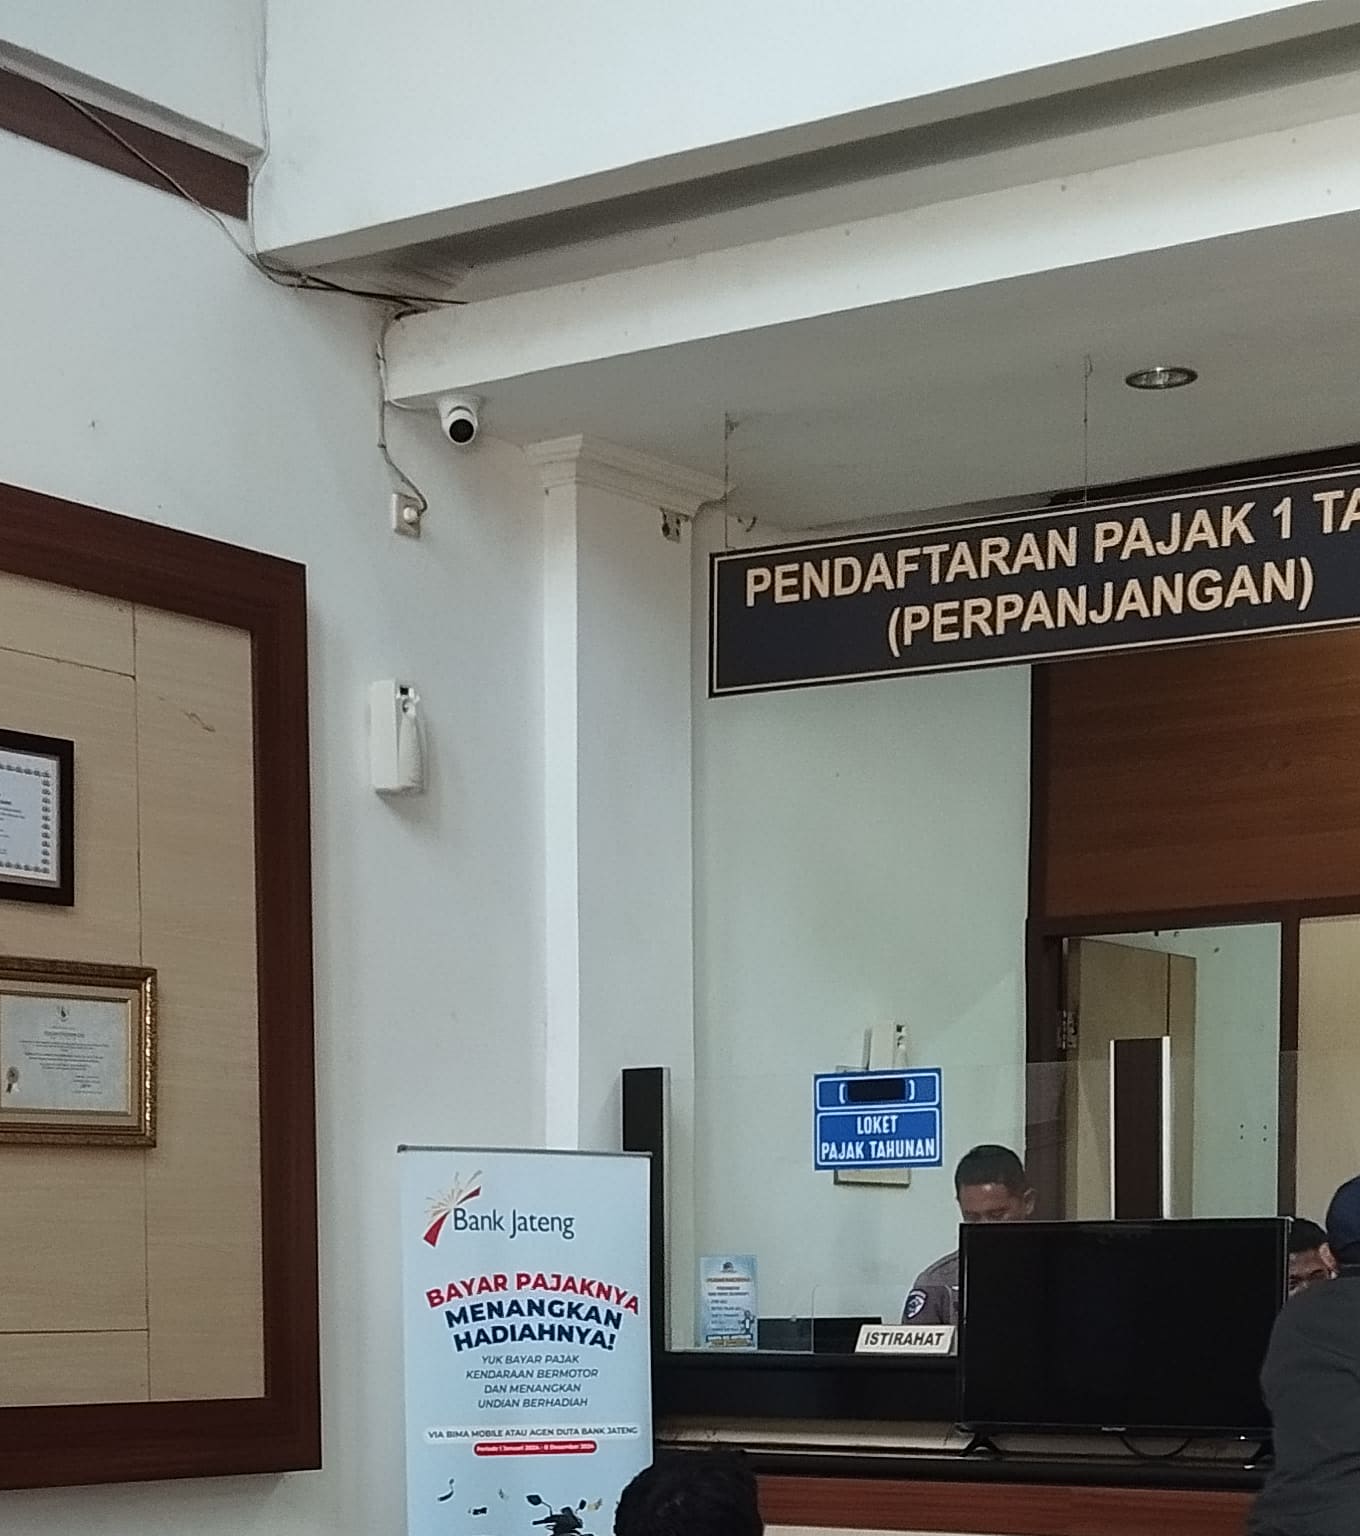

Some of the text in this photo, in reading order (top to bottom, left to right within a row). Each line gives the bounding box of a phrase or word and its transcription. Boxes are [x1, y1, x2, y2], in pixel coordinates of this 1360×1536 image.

[745, 527, 1078, 606] PENDAFTARAN
[1095, 504, 1254, 564] PAJAK
[1273, 497, 1292, 540] 1
[887, 557, 1315, 657] (PERPANJANGAN)
[856, 1115, 898, 1135] LOKET
[821, 1138, 935, 1160] PAJAK TAHUNAN
[453, 1206, 575, 1239] Bank Jateng
[426, 1273, 640, 1315] BAYAR PAJAKNYA
[445, 1299, 623, 1330] MENANGKAN
[453, 1323, 616, 1352] HADIAHNYA!
[865, 1332, 944, 1345] ISTIRAHAT
[482, 1355, 580, 1365] YUK BAYAR PAJAK
[466, 1369, 599, 1379] KENDARAAN BERMOTOR
[484, 1384, 581, 1394] DAN MENANGKAN
[478, 1398, 588, 1409] UNDIAN BERHADIAH
[471, 1429, 503, 1438] MOBILE
[505, 1429, 527, 1437] ATAU
[556, 1428, 579, 1436] DUTA
[581, 1427, 604, 1435] BANK
[606, 1426, 638, 1434] JATENG
